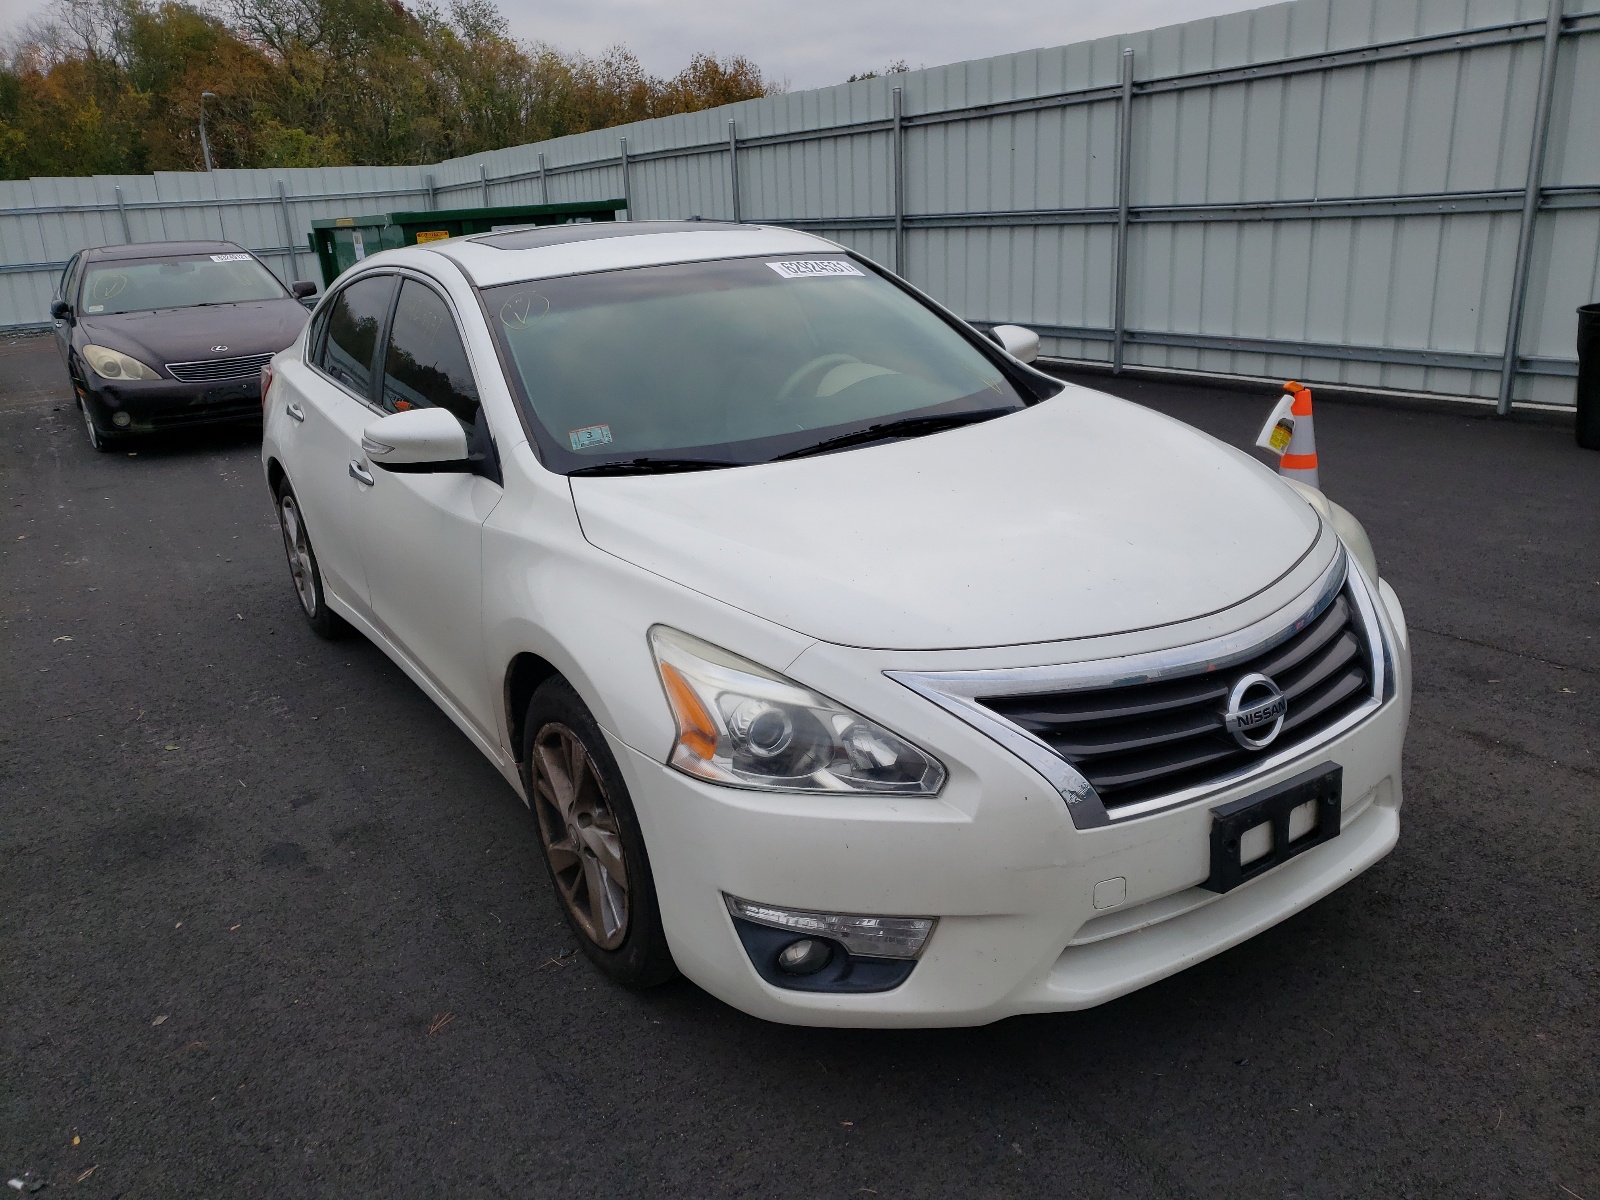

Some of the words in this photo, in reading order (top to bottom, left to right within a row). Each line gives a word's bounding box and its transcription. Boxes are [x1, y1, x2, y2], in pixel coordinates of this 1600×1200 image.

[780, 261, 849, 273] 62924531
[586, 431, 593, 439] 3
[1236, 701, 1286, 728] NISSAN
